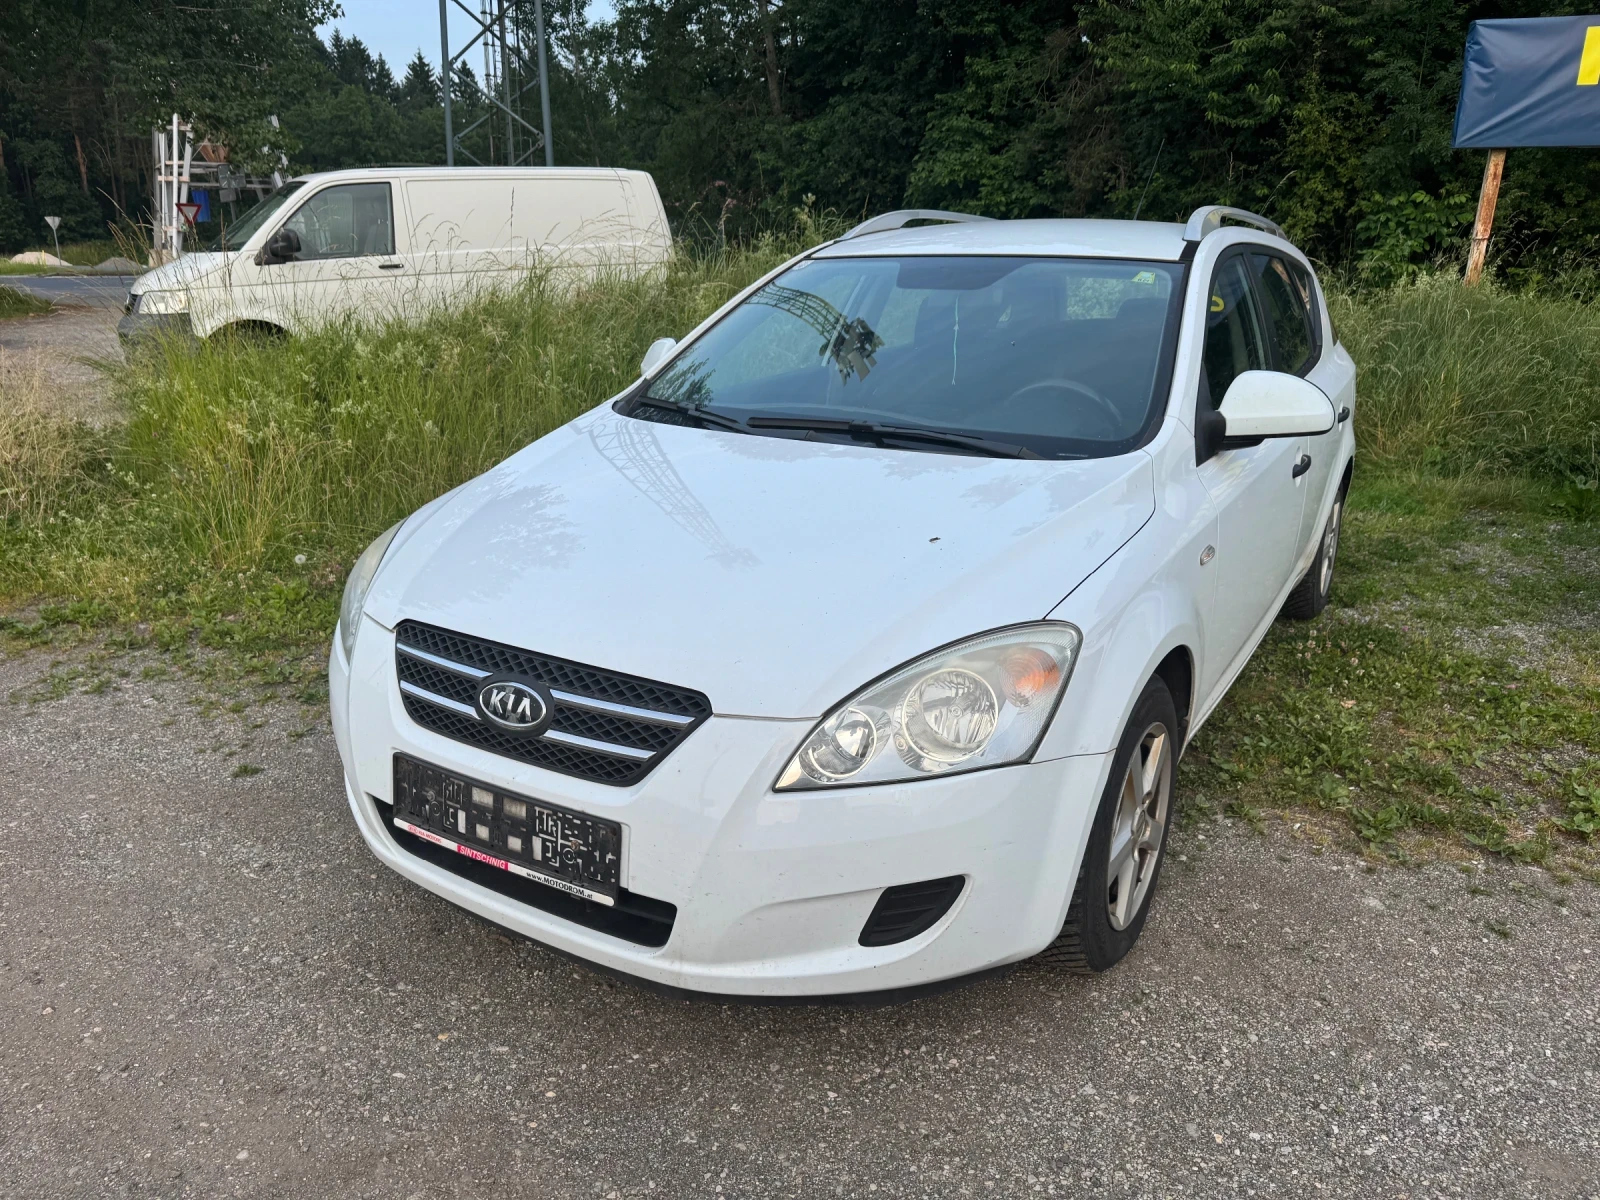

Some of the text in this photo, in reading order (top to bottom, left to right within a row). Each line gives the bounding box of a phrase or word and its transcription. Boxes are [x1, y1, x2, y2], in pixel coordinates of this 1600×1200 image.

[488, 688, 532, 722] KIA
[459, 845, 506, 869] SINTSCHNIG
[526, 871, 593, 900] www.MOTODROM.at
